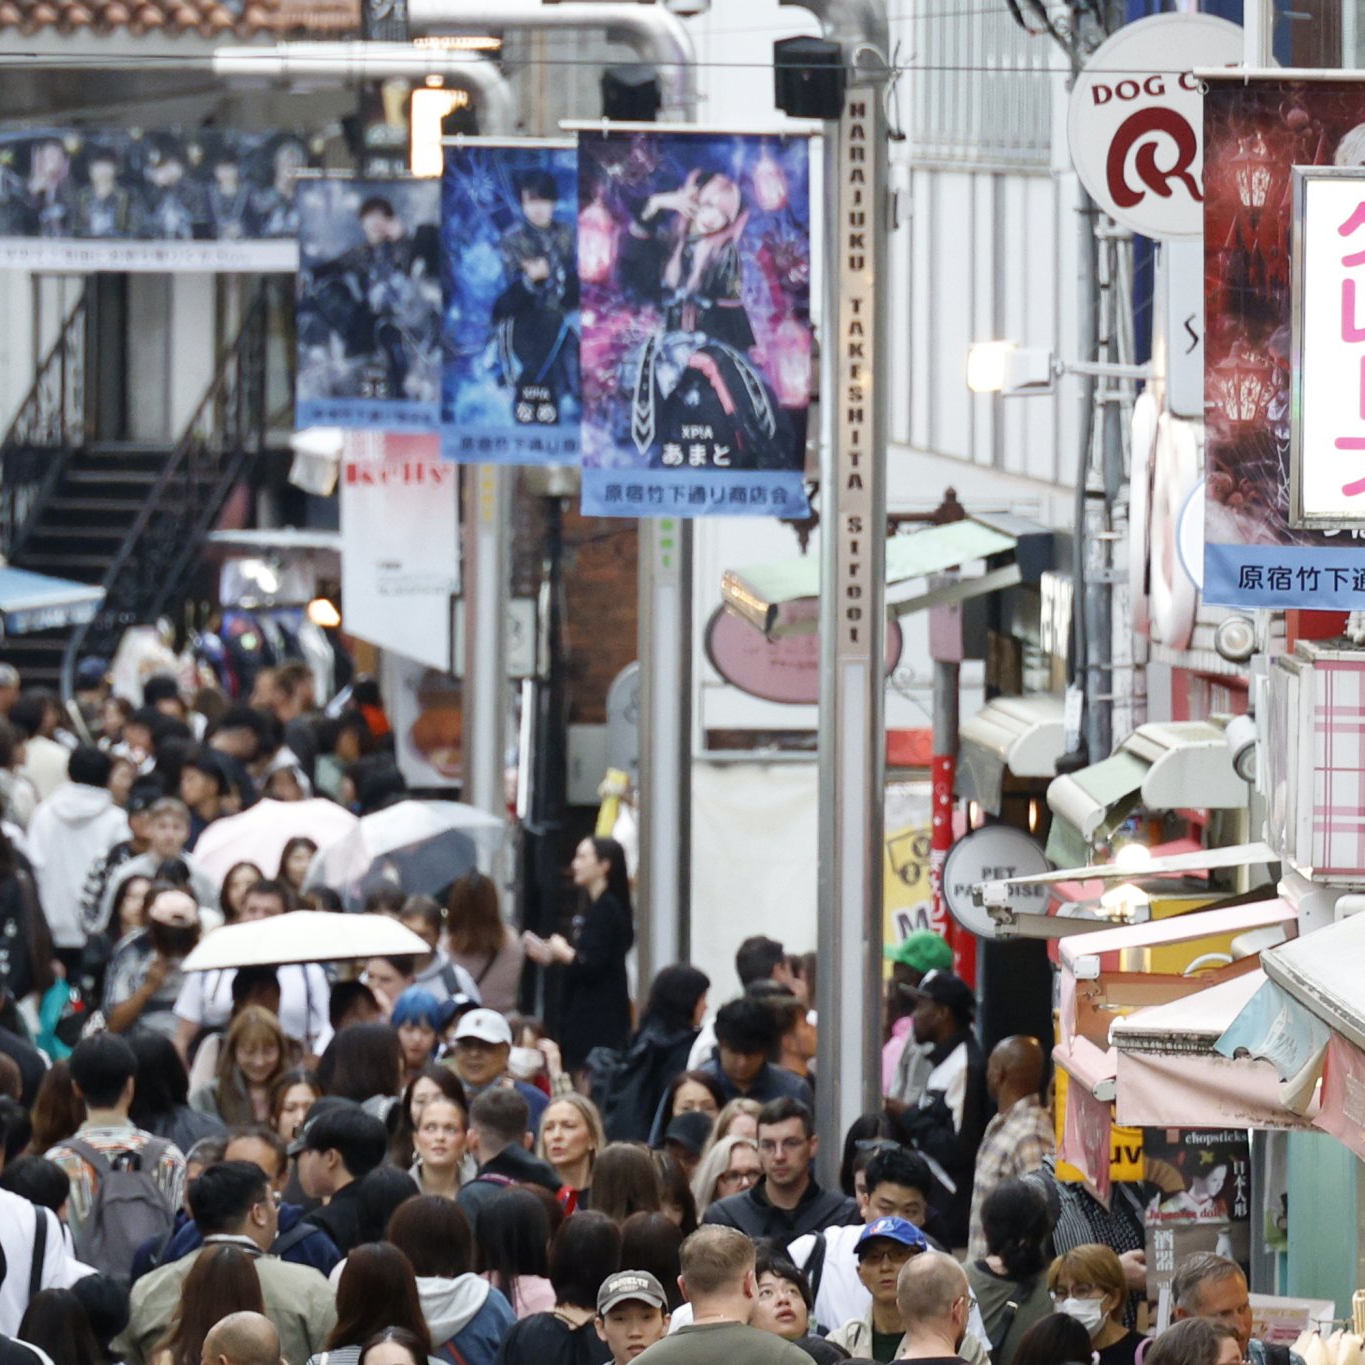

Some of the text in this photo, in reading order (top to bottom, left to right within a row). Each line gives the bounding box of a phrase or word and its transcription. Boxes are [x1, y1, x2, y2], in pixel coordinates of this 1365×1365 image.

[1092, 77, 1166, 105] DOG
[848, 102, 866, 272] HARAJUKU
[847, 298, 866, 491] TAKESHITA
[661, 443, 732, 466] あまと
[605, 484, 787, 504] 原宿竹下通り商店会
[981, 866, 1017, 880] PET
[1185, 1130, 1247, 1146] chopsticks
[1233, 1160, 1248, 1218] 日本人形
